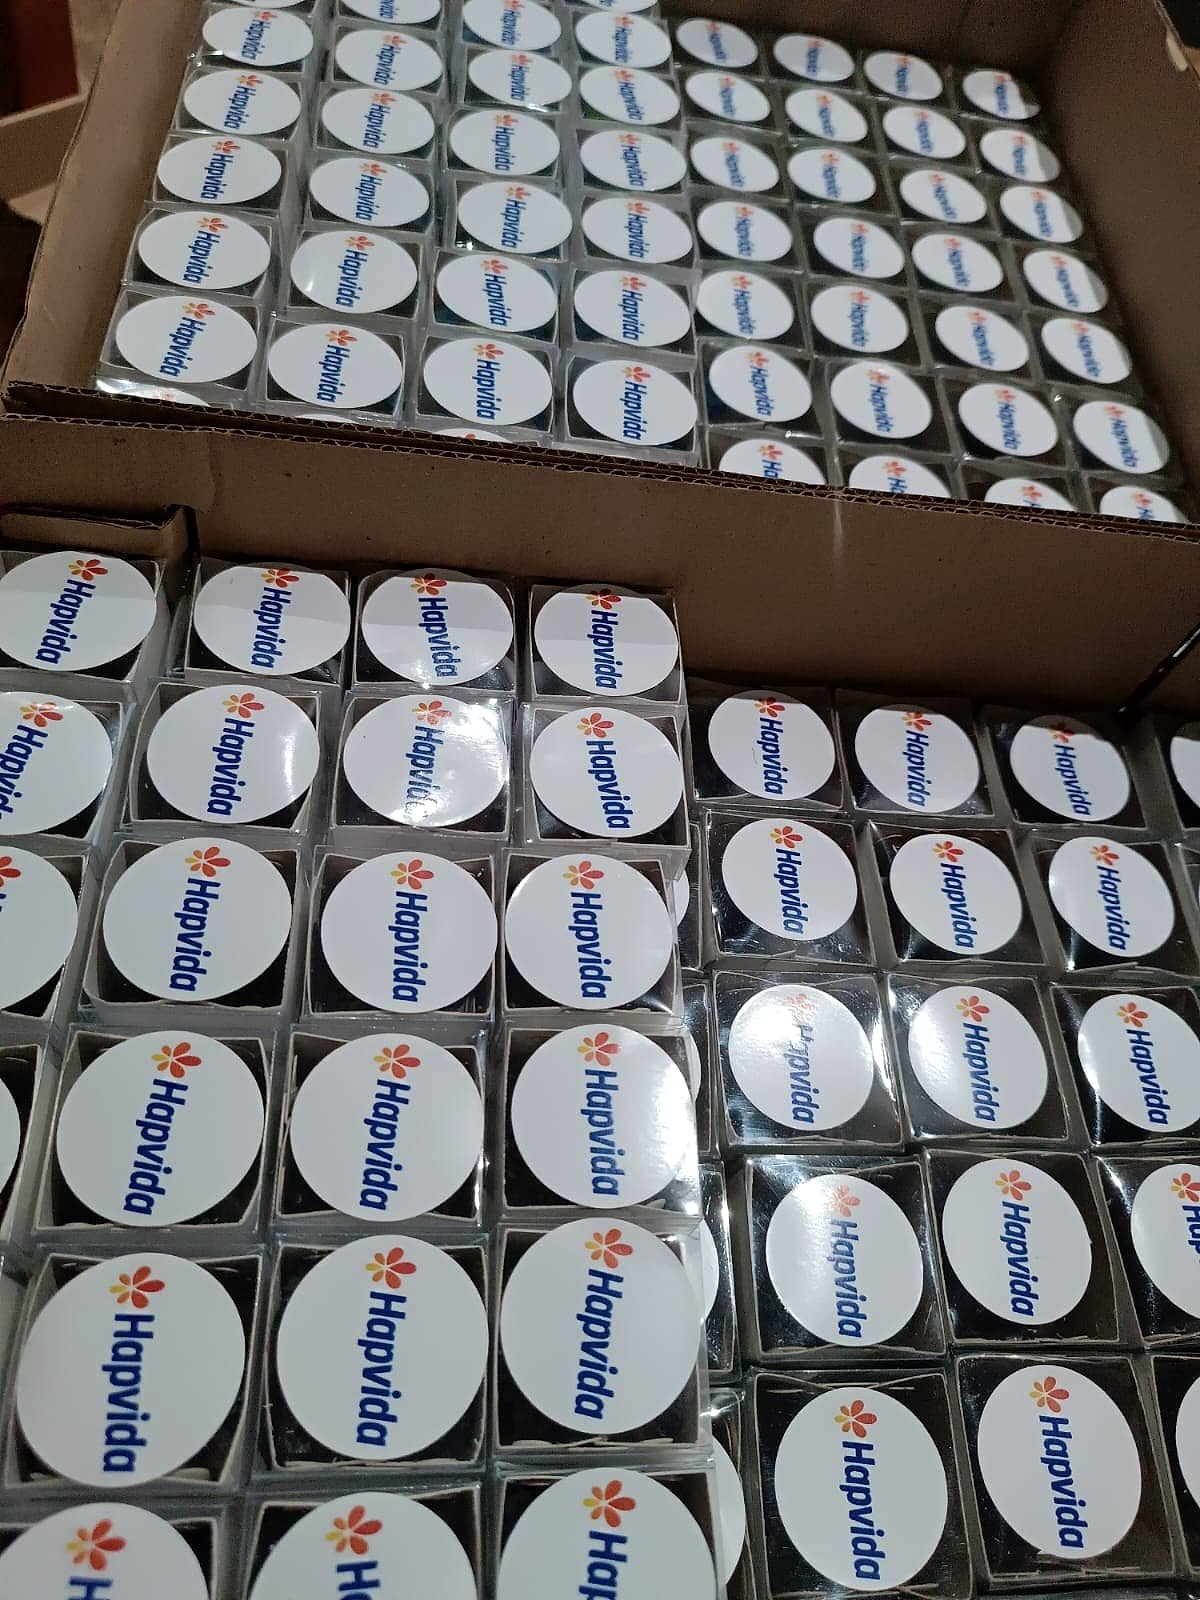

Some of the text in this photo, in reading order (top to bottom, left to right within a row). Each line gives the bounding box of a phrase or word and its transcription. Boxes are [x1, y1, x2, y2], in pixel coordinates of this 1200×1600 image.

[224, 86, 256, 129] Hapvida
[363, 103, 390, 148] Hapvida
[492, 125, 515, 171] Hapvida
[200, 153, 234, 199] Hapvida
[355, 174, 382, 221] Hapvida
[183, 230, 220, 283] Hapvida
[500, 199, 526, 248] Hapvida
[624, 213, 650, 258] Hapvida
[336, 249, 368, 307] Hapvida
[482, 274, 512, 326] Hapvida
[618, 289, 645, 341] Hapvida
[160, 317, 206, 377] Hapvida
[317, 345, 350, 402] Hapvida
[472, 359, 502, 419] Hapvida
[620, 381, 647, 440] Hapvida
[749, 366, 774, 416] Hapvida
[35, 579, 96, 664] Hapvida
[251, 587, 292, 668] Hapvida
[418, 598, 461, 677] Hapvida
[587, 610, 623, 689] Hapvida
[207, 718, 255, 815] Hapvida
[586, 741, 633, 828] Hapvida
[757, 717, 788, 794] Hapvida
[902, 730, 932, 806] Hapvida
[1054, 744, 1092, 815] Hapvida
[774, 848, 808, 934] Hapvida
[940, 863, 978, 948] Hapvida
[1097, 866, 1130, 950] Hapvida
[169, 878, 221, 991] Hapvida
[388, 891, 428, 1002] Hapvida
[568, 892, 612, 998] Hapvida
[962, 1023, 1000, 1121] Hapvida
[1126, 1029, 1171, 1124] Hapvida
[123, 1079, 188, 1215] Hapvida
[360, 1079, 411, 1211] Hapvida
[580, 1069, 625, 1195] Hapvida
[827, 1221, 867, 1338] Hapvida
[1000, 1201, 1039, 1317] Hapvida
[356, 1291, 407, 1446] Hapvida
[574, 1269, 624, 1419] Hapvida
[101, 1314, 155, 1472] Hapvida
[839, 1441, 885, 1580] Hapvida
[1039, 1416, 1088, 1548] Hapvida
